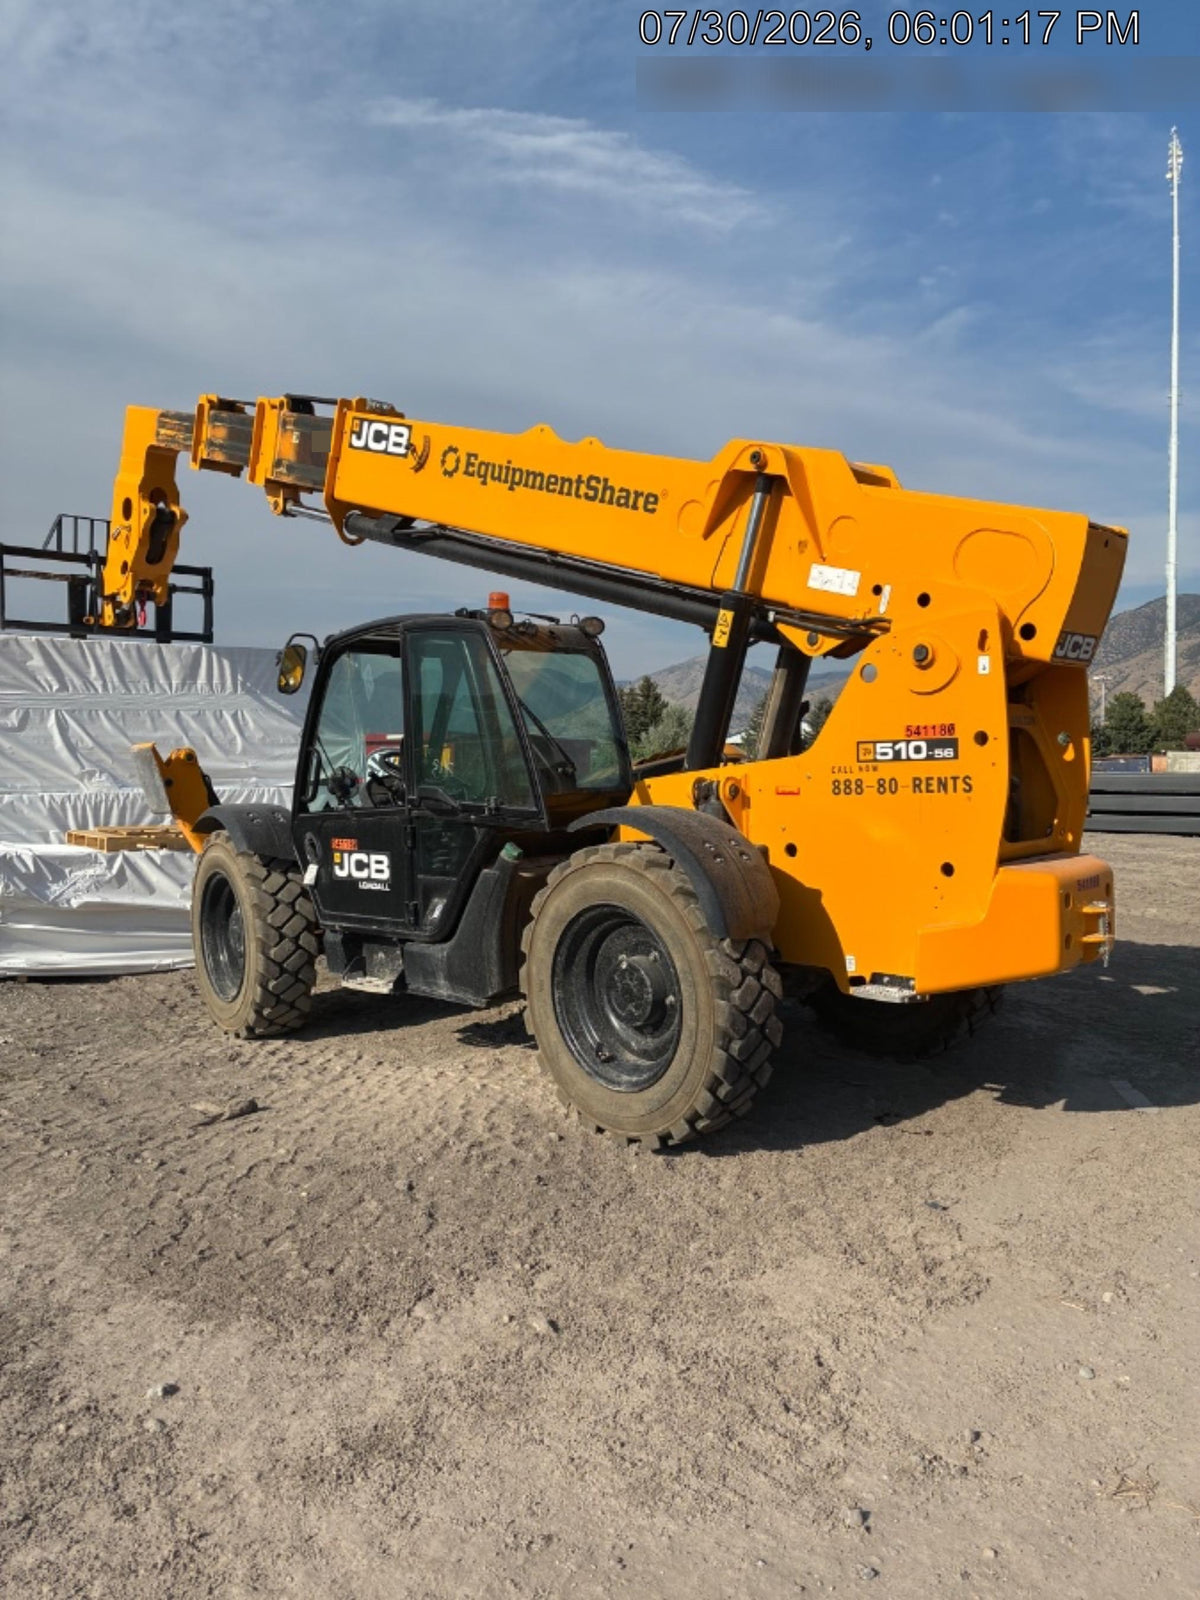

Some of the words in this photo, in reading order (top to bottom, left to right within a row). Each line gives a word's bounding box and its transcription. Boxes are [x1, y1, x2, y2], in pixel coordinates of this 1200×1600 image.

[350, 421, 410, 455] JCB
[462, 452, 660, 514] EquipmentShare
[1055, 633, 1097, 660] JCB
[905, 723, 956, 738] 541180
[875, 740, 955, 760] 510-56
[334, 852, 391, 880] JCB
